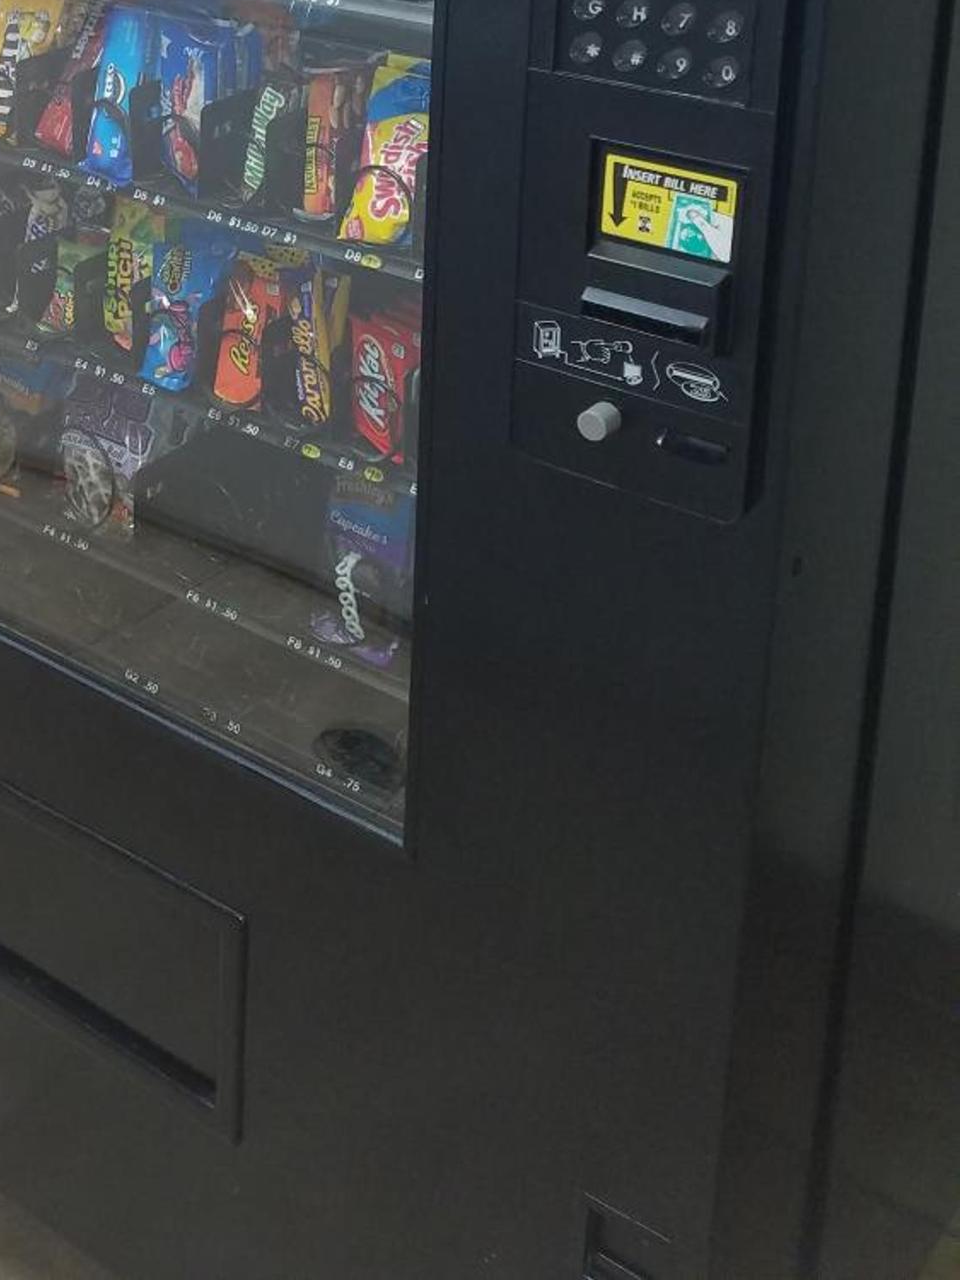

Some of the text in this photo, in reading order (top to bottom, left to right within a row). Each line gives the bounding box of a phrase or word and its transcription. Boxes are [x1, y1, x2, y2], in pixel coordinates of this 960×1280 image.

[589, 0, 736, 36] G H 7 8
[676, 57, 687, 72] 9
[721, 65, 733, 80] 0
[622, 165, 719, 198] INSERT BILL HERE
[261, 225, 278, 237] D7
[344, 248, 362, 262] D8
